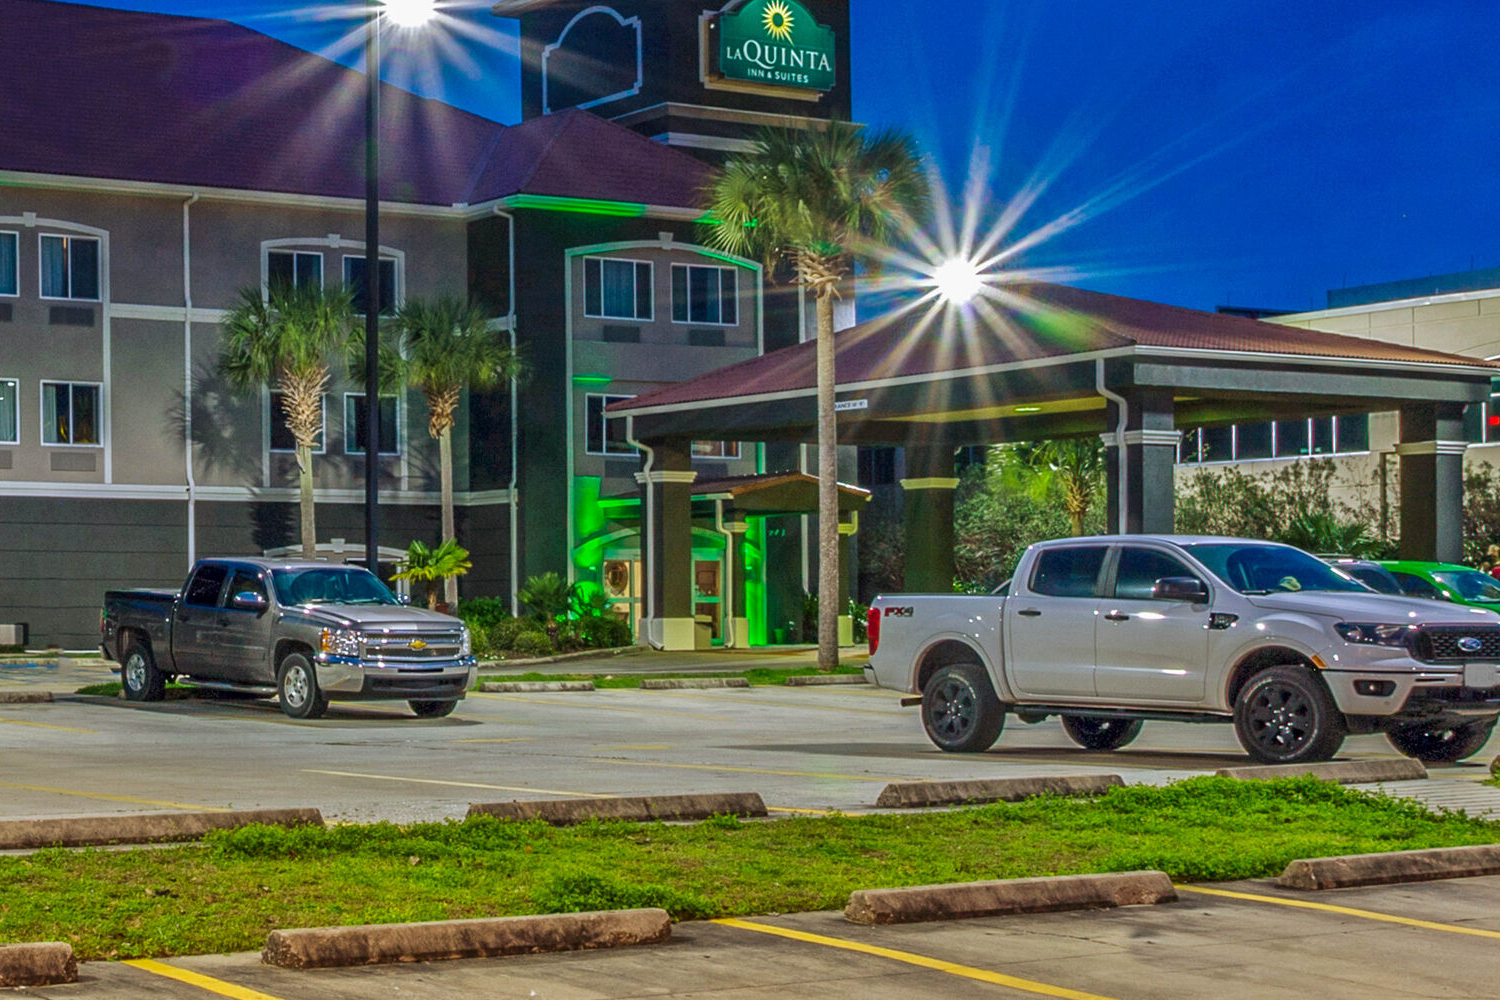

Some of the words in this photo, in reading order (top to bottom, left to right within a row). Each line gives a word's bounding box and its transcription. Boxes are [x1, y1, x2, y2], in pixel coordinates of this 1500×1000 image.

[726, 46, 743, 61] LA
[743, 39, 832, 72] QUINTA
[747, 68, 765, 78] INN
[774, 71, 809, 84] SUITES
[884, 606, 914, 617] FX4
